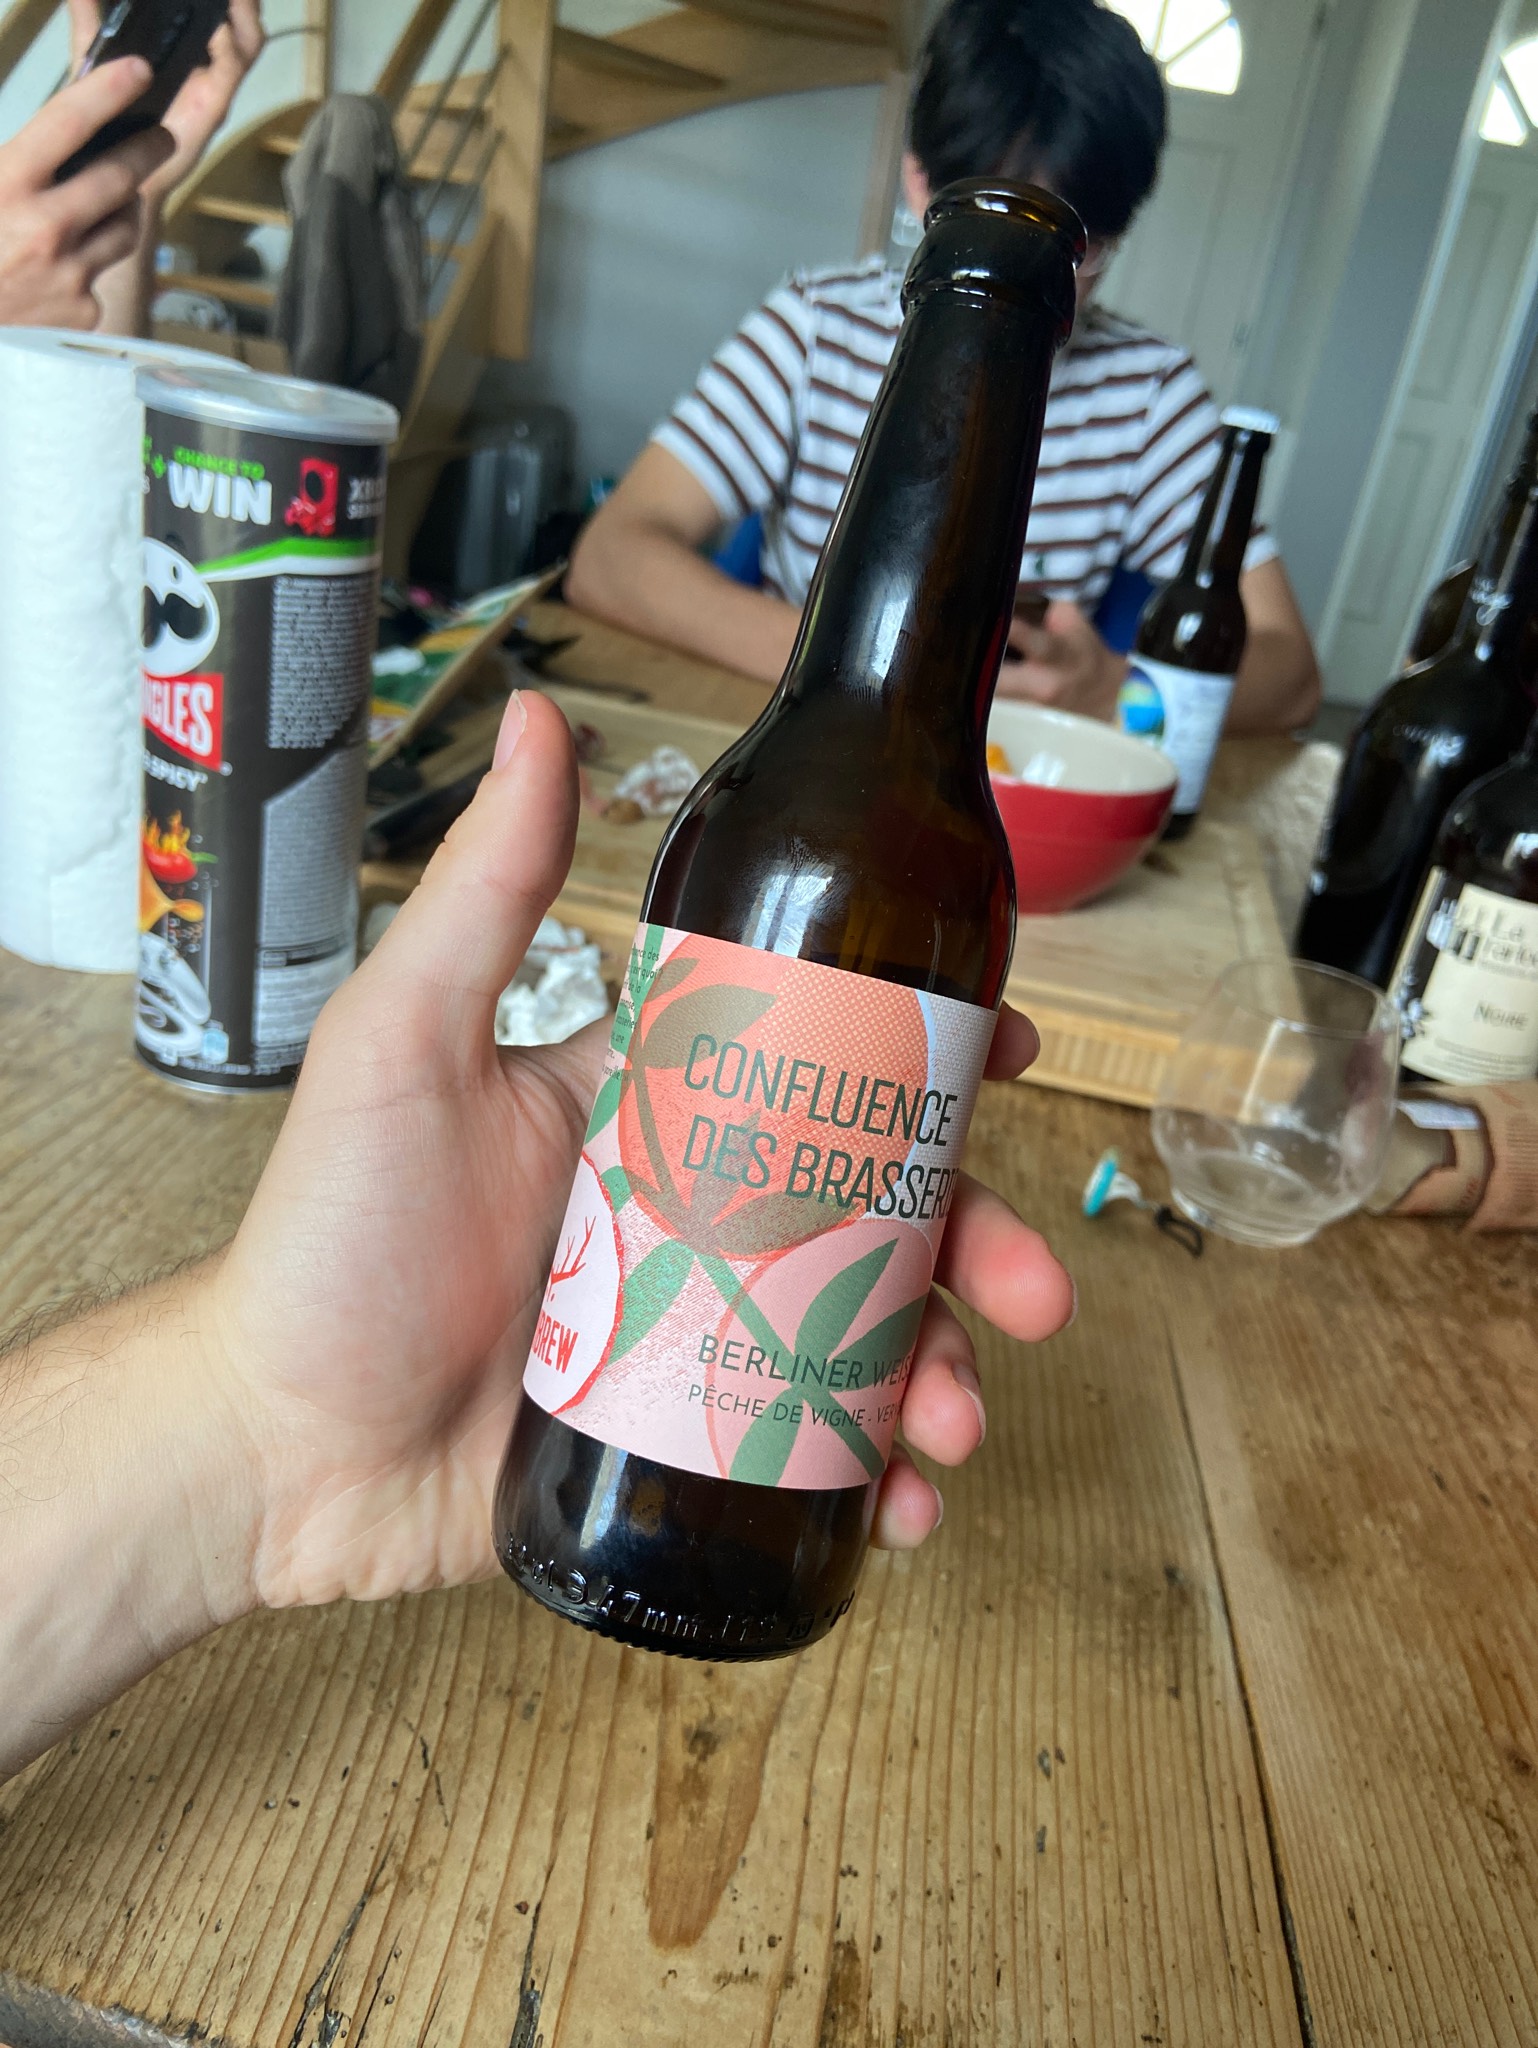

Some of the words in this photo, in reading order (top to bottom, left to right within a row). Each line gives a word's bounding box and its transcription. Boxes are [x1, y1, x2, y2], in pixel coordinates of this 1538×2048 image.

[168, 459, 273, 526] WIN
[684, 1033, 958, 1147] CONFLUENCE
[682, 1114, 778, 1190] DES
[785, 1141, 959, 1220] BRASSERI
[698, 1334, 863, 1389] BERLINER
[873, 1354, 912, 1389] WEIS
[688, 1383, 767, 1418] PÊCHE
[773, 1401, 804, 1424] DE
[811, 1406, 866, 1428] VIGNE
